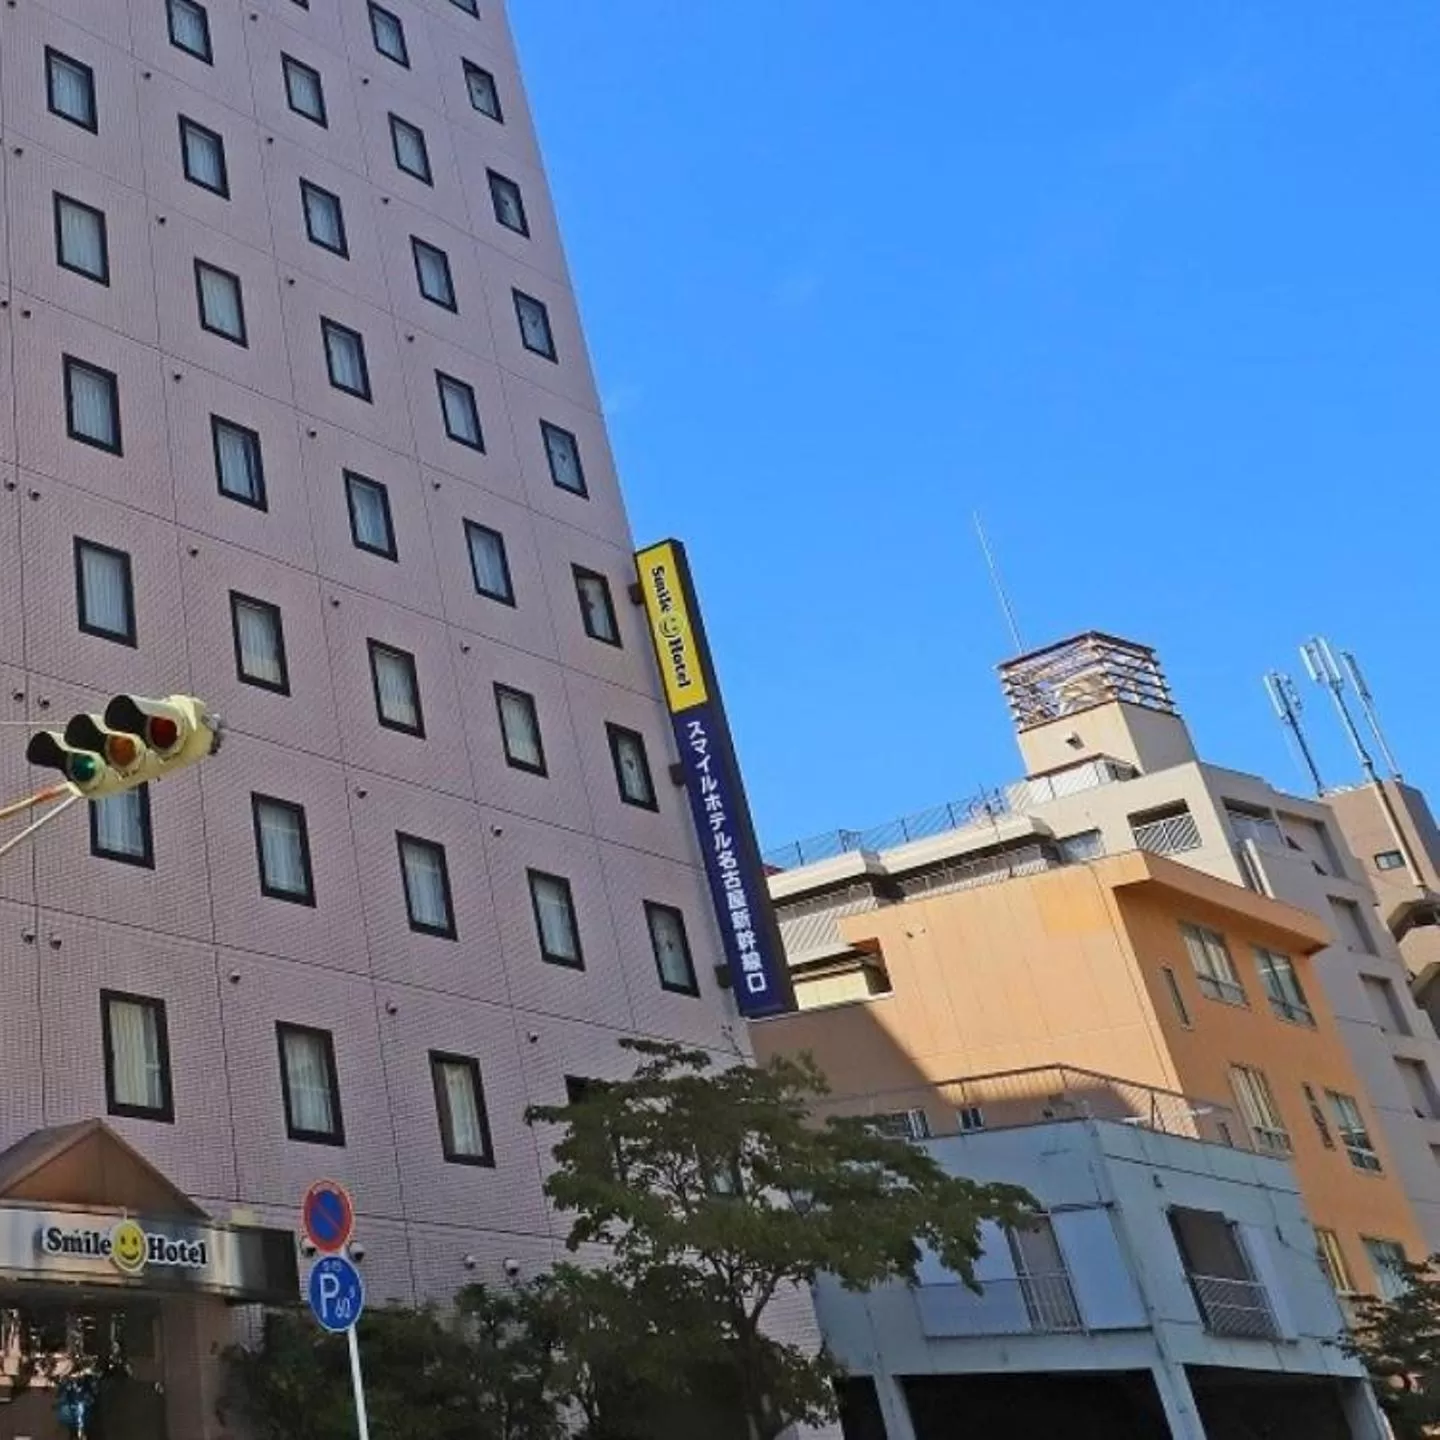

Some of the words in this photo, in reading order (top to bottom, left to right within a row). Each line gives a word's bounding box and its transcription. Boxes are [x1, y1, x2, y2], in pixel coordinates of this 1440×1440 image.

[651, 565, 673, 614] Smile
[668, 637, 692, 688] Hotel
[687, 719, 767, 994] スマイルホテル名古屋新幹線口
[46, 1226, 112, 1255] Smile
[146, 1234, 207, 1265] Hotel
[320, 1272, 340, 1319] P
